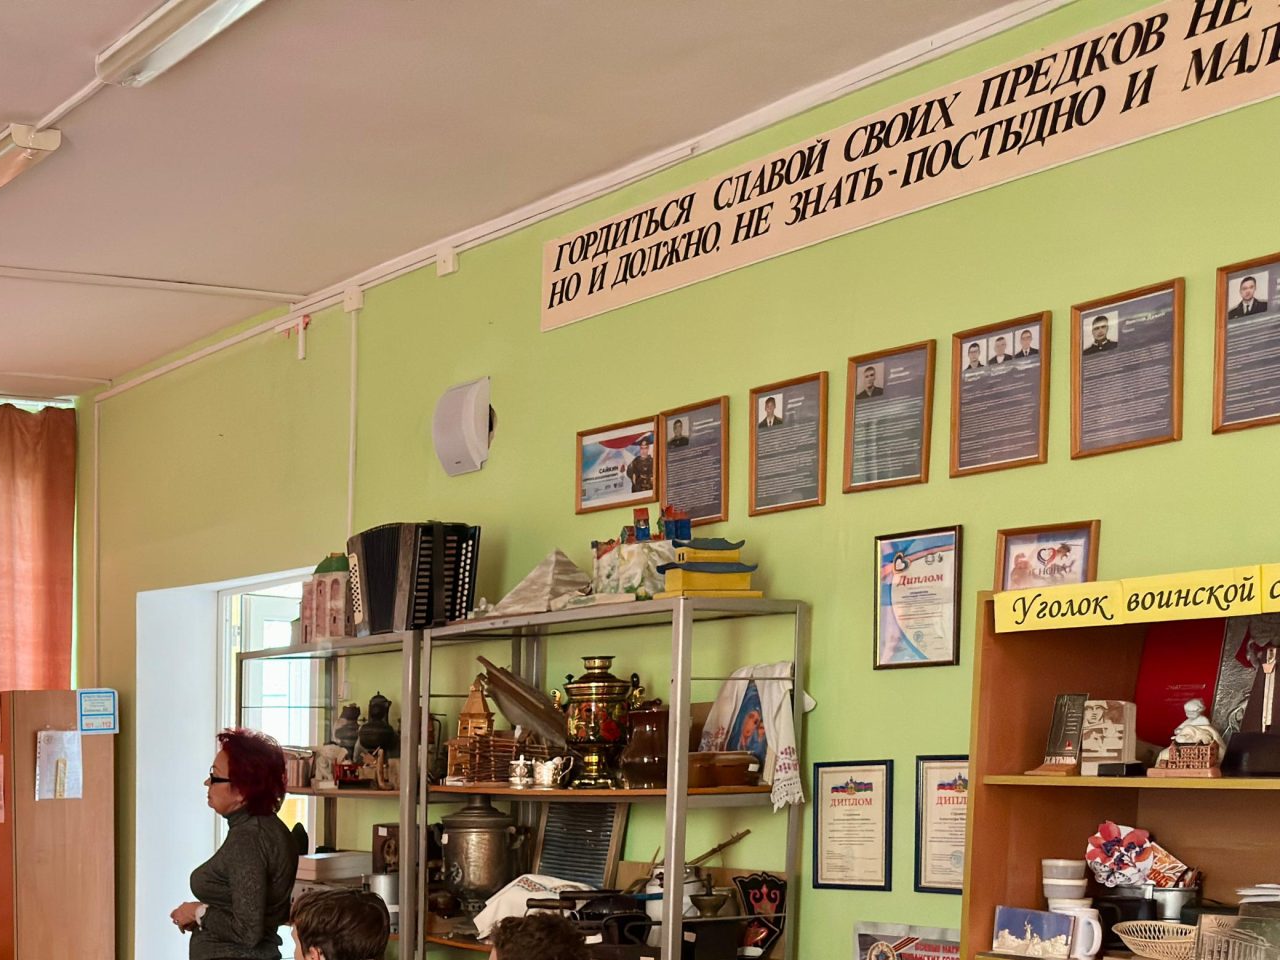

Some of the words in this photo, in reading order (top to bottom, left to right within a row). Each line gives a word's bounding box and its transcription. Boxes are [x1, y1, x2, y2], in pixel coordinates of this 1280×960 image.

[553, 192, 696, 273] ГОРДИТЬСЯ
[713, 138, 830, 210] СЛАВОЙ
[844, 91, 962, 162] СВОИХ
[974, 12, 1169, 117] ПРЕДКОВ
[1183, 0, 1253, 40] НЕ
[548, 272, 581, 309] НО
[587, 262, 607, 295] И
[730, 202, 774, 245] НЕ
[1119, 64, 1158, 114] И
[897, 574, 944, 586] Диплом
[1012, 594, 1114, 625] Уголок
[1127, 576, 1255, 611] воинской
[830, 797, 873, 808] ДИПЛОМ
